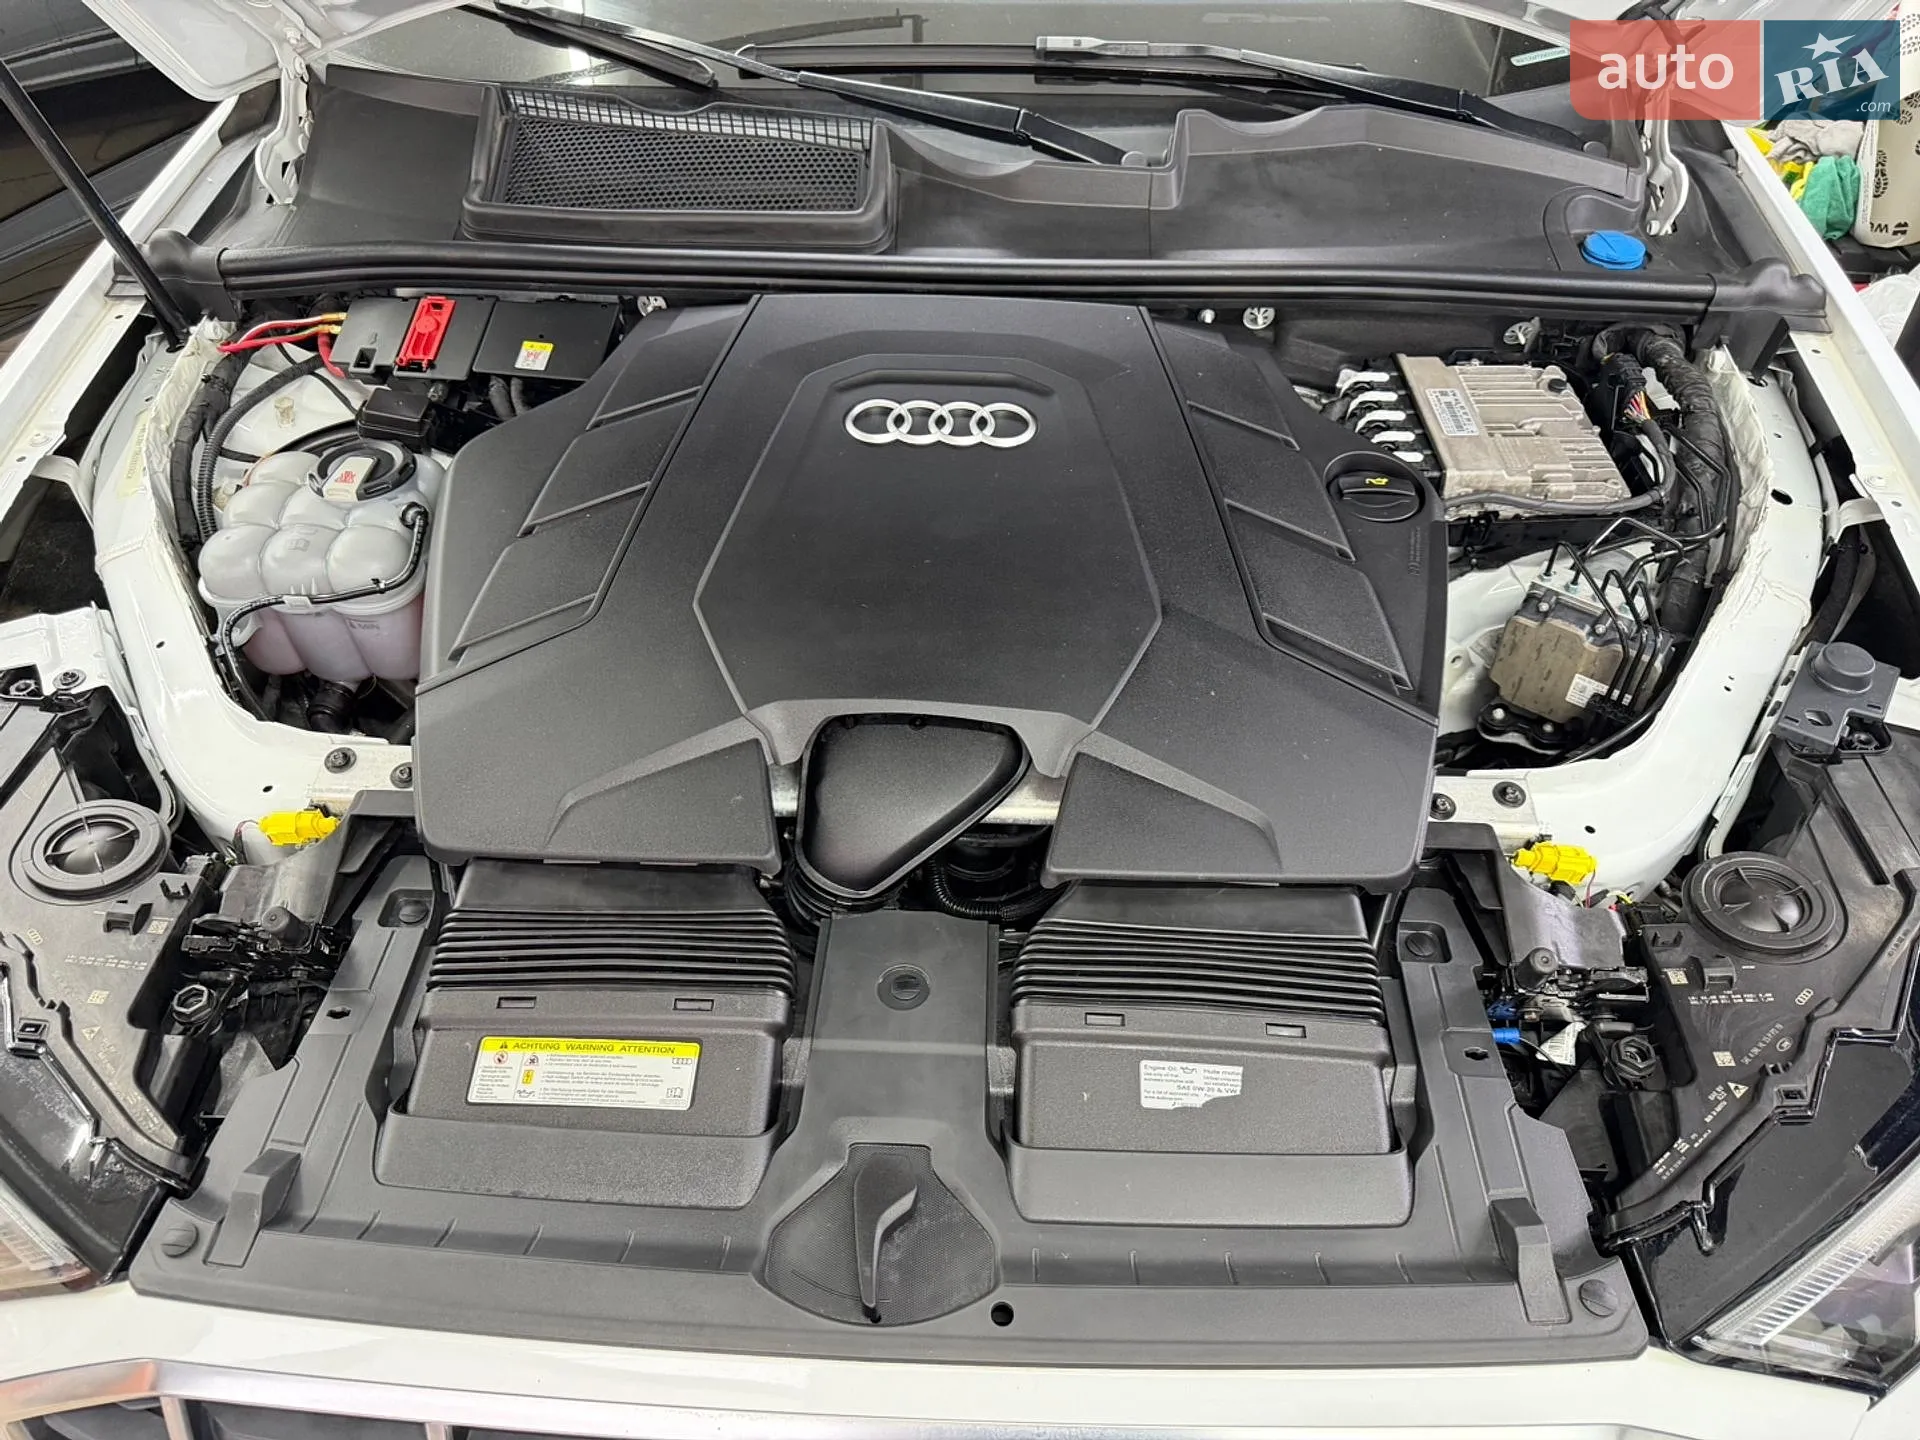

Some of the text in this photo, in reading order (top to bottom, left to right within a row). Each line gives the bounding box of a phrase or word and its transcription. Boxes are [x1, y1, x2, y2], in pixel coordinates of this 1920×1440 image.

[513, 1042, 676, 1054] ACHTUNG WARNING ATTENTION
